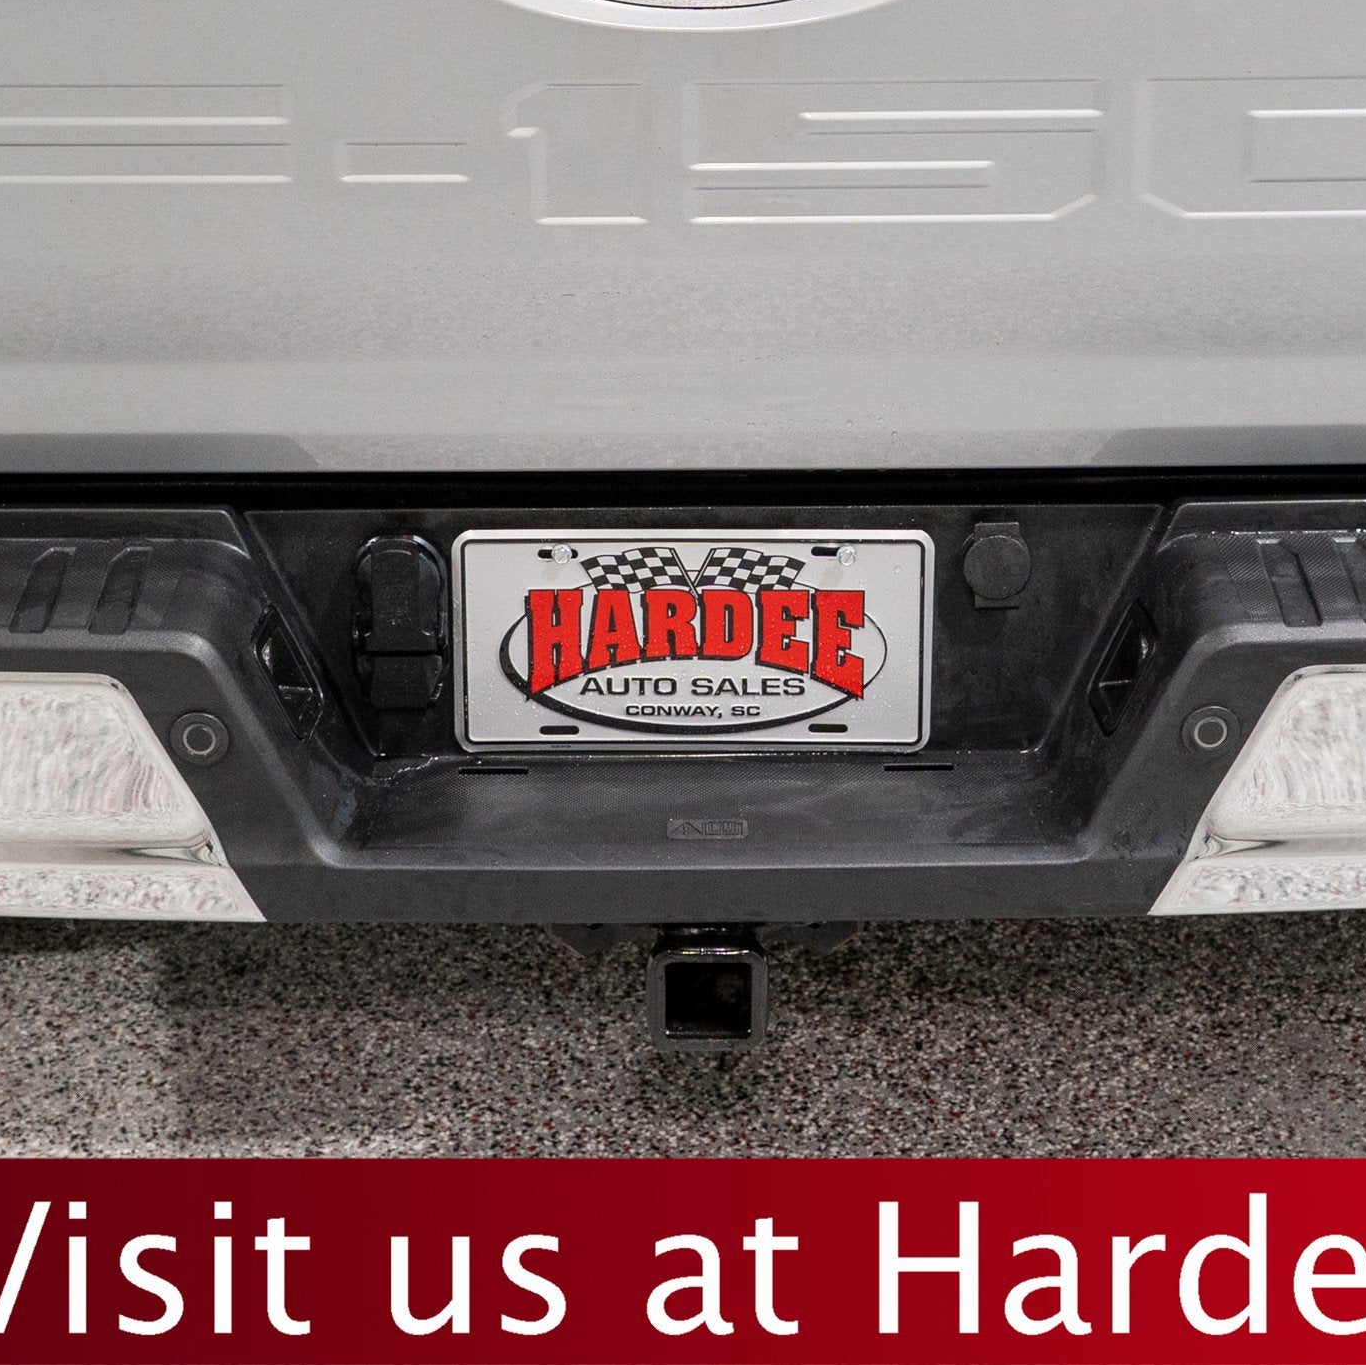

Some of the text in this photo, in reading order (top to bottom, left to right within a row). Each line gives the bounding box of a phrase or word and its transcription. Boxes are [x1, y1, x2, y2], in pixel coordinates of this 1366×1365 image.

[525, 588, 866, 701] HARDEE
[579, 677, 806, 697] AUTO SALES
[625, 705, 761, 719] CONWAY, SC
